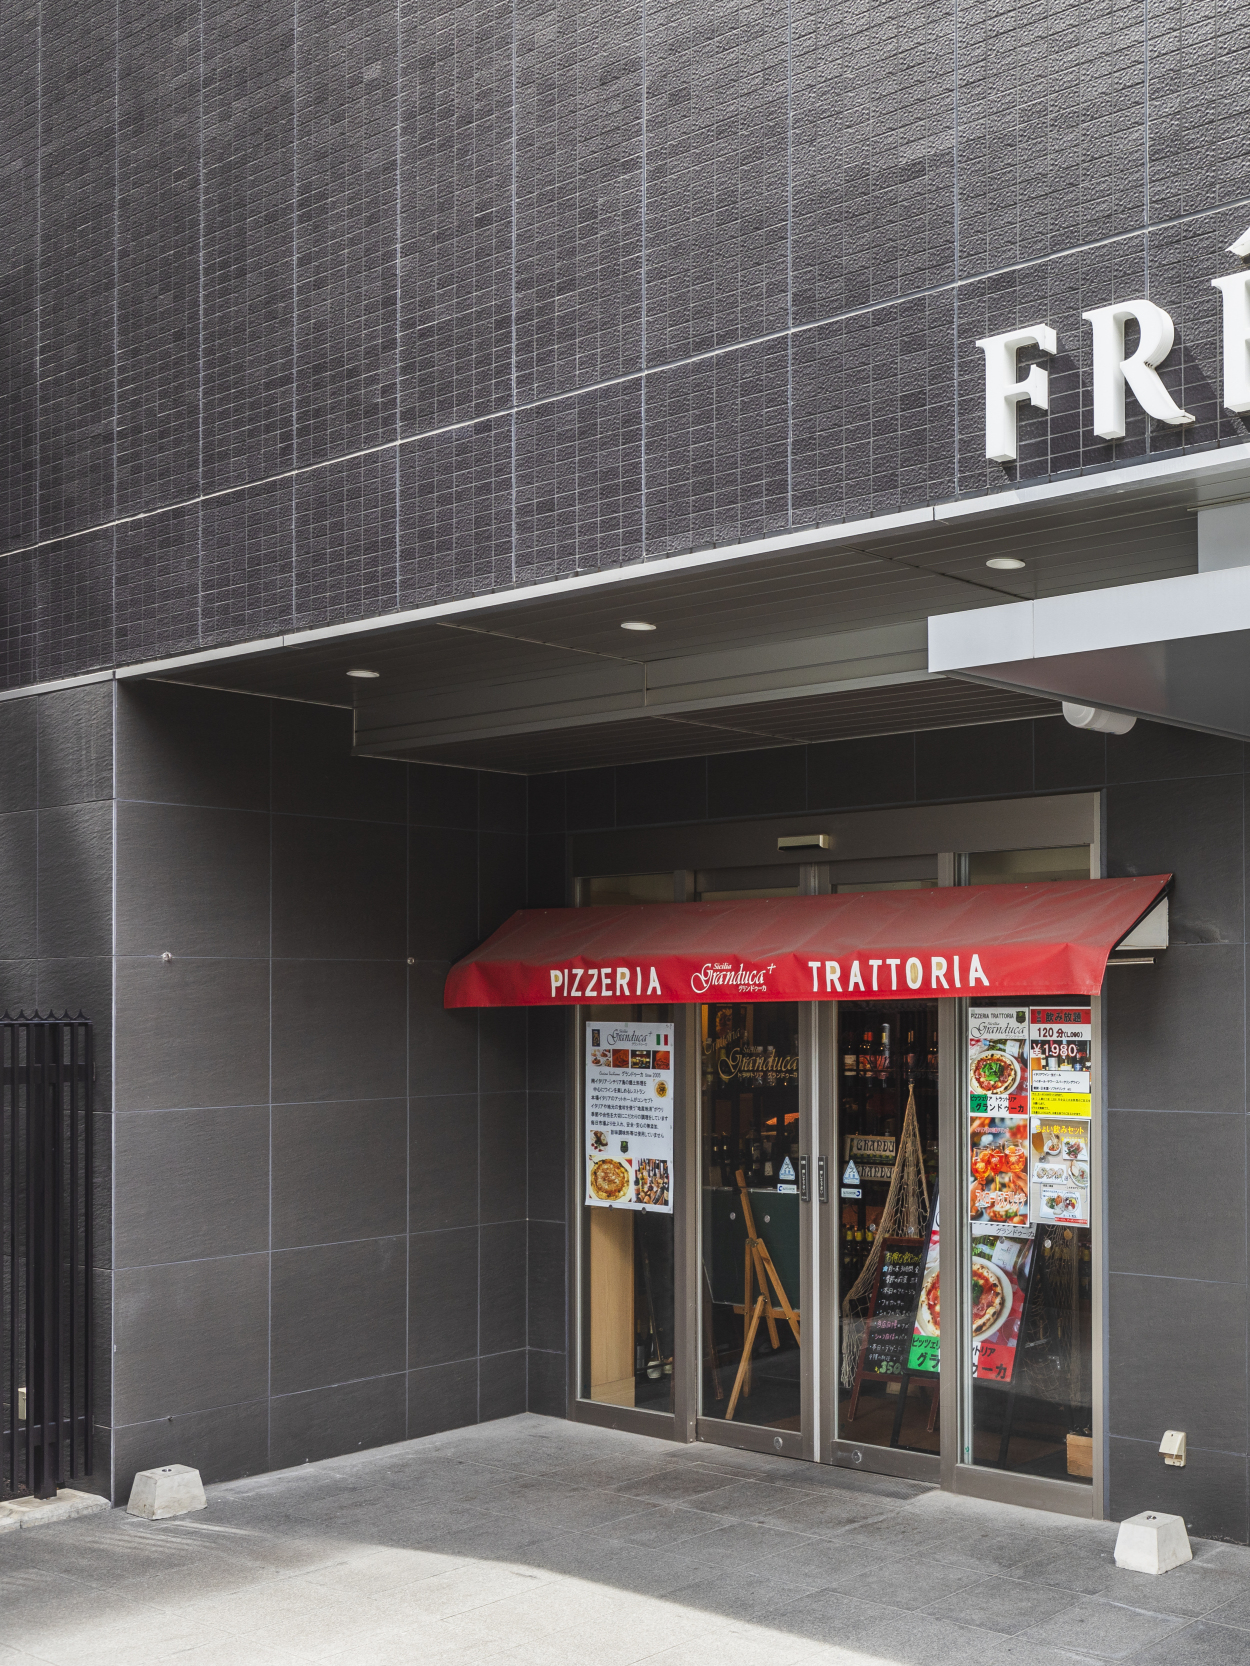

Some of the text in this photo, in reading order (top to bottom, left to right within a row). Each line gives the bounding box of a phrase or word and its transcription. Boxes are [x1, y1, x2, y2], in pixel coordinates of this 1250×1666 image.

[807, 953, 990, 993] TRATTORIA
[550, 966, 662, 998] PIZZERIA
[1045, 1011, 1082, 1023] 飲み放題
[970, 1021, 1026, 1039] Granduca
[1032, 1043, 1077, 1057] ¥1980
[975, 1102, 1024, 1113] グランドゥーカ
[1035, 1124, 1085, 1135] ちょい飲みセット
[996, 1227, 1036, 1238] グランドゥーカ
